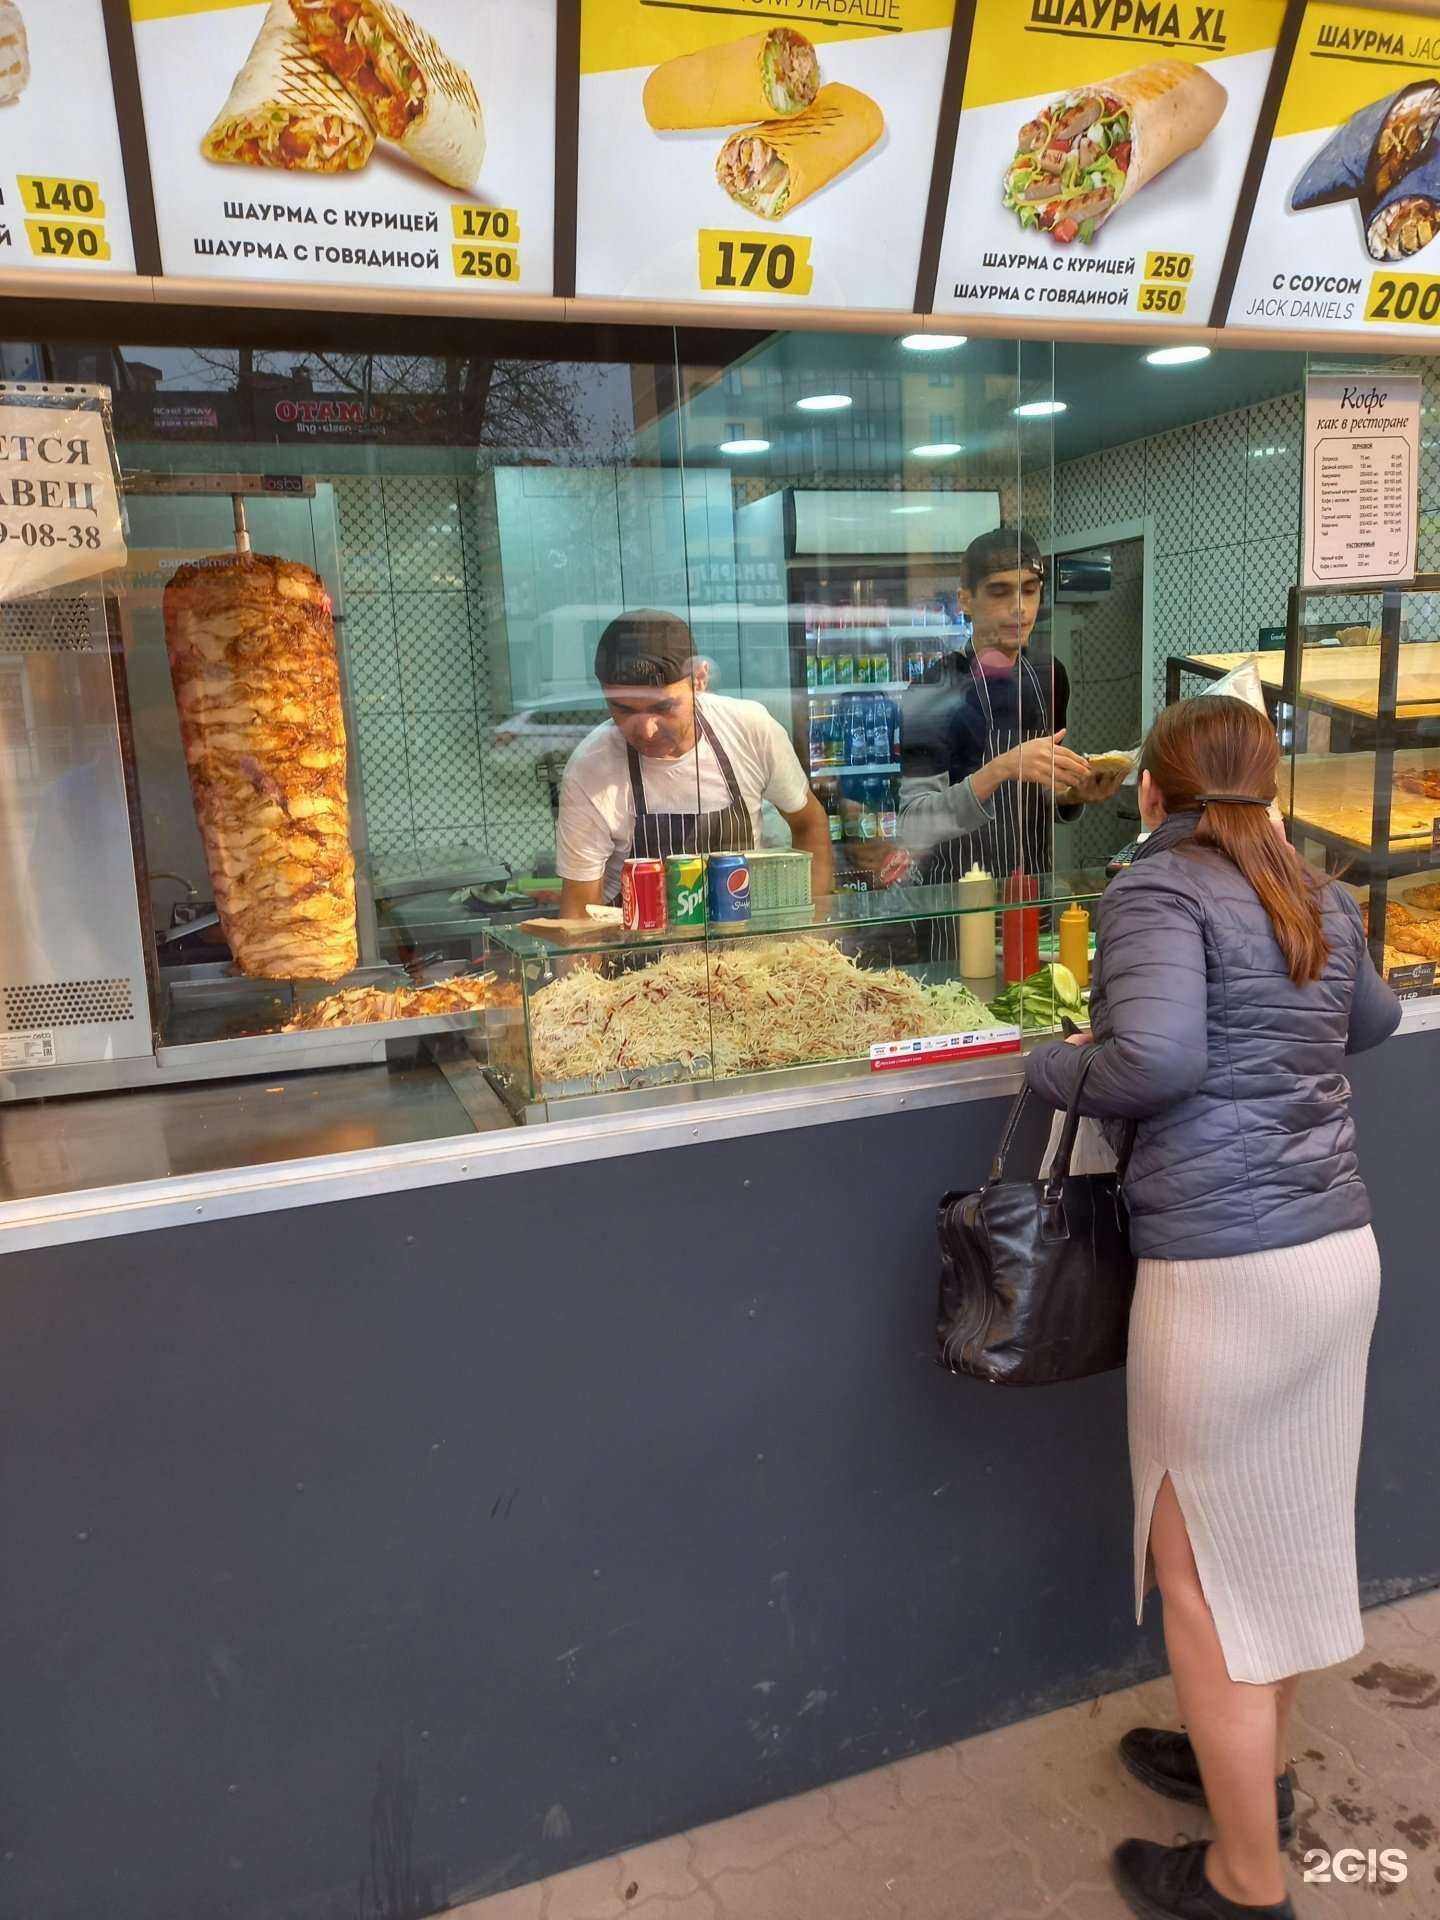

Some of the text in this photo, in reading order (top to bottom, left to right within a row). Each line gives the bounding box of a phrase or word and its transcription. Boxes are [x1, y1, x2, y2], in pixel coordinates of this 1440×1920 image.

[1031, 0, 1228, 43] ШАУРМА XL
[1317, 25, 1404, 56] ШАУРМА
[32, 181, 94, 212] 140
[223, 201, 509, 238] ШАУРМА С КУРИЦЕЙ 170
[38, 226, 98, 256] 190
[194, 238, 512, 278] ШАУРМА С ГОВЯДИНОЙ 250
[716, 241, 795, 289] 170
[982, 253, 1190, 278] ШАУРМА С КУРИЦЕЙ 250
[953, 284, 1182, 311] ШАУРМА С ГОВЯДИНОЙ 350
[1246, 297, 1354, 320] JACK DANIELS
[1272, 273, 1440, 321] С СОУСОМ 200
[1341, 386, 1388, 415] Кофе
[1316, 417, 1409, 433] как в ресторане
